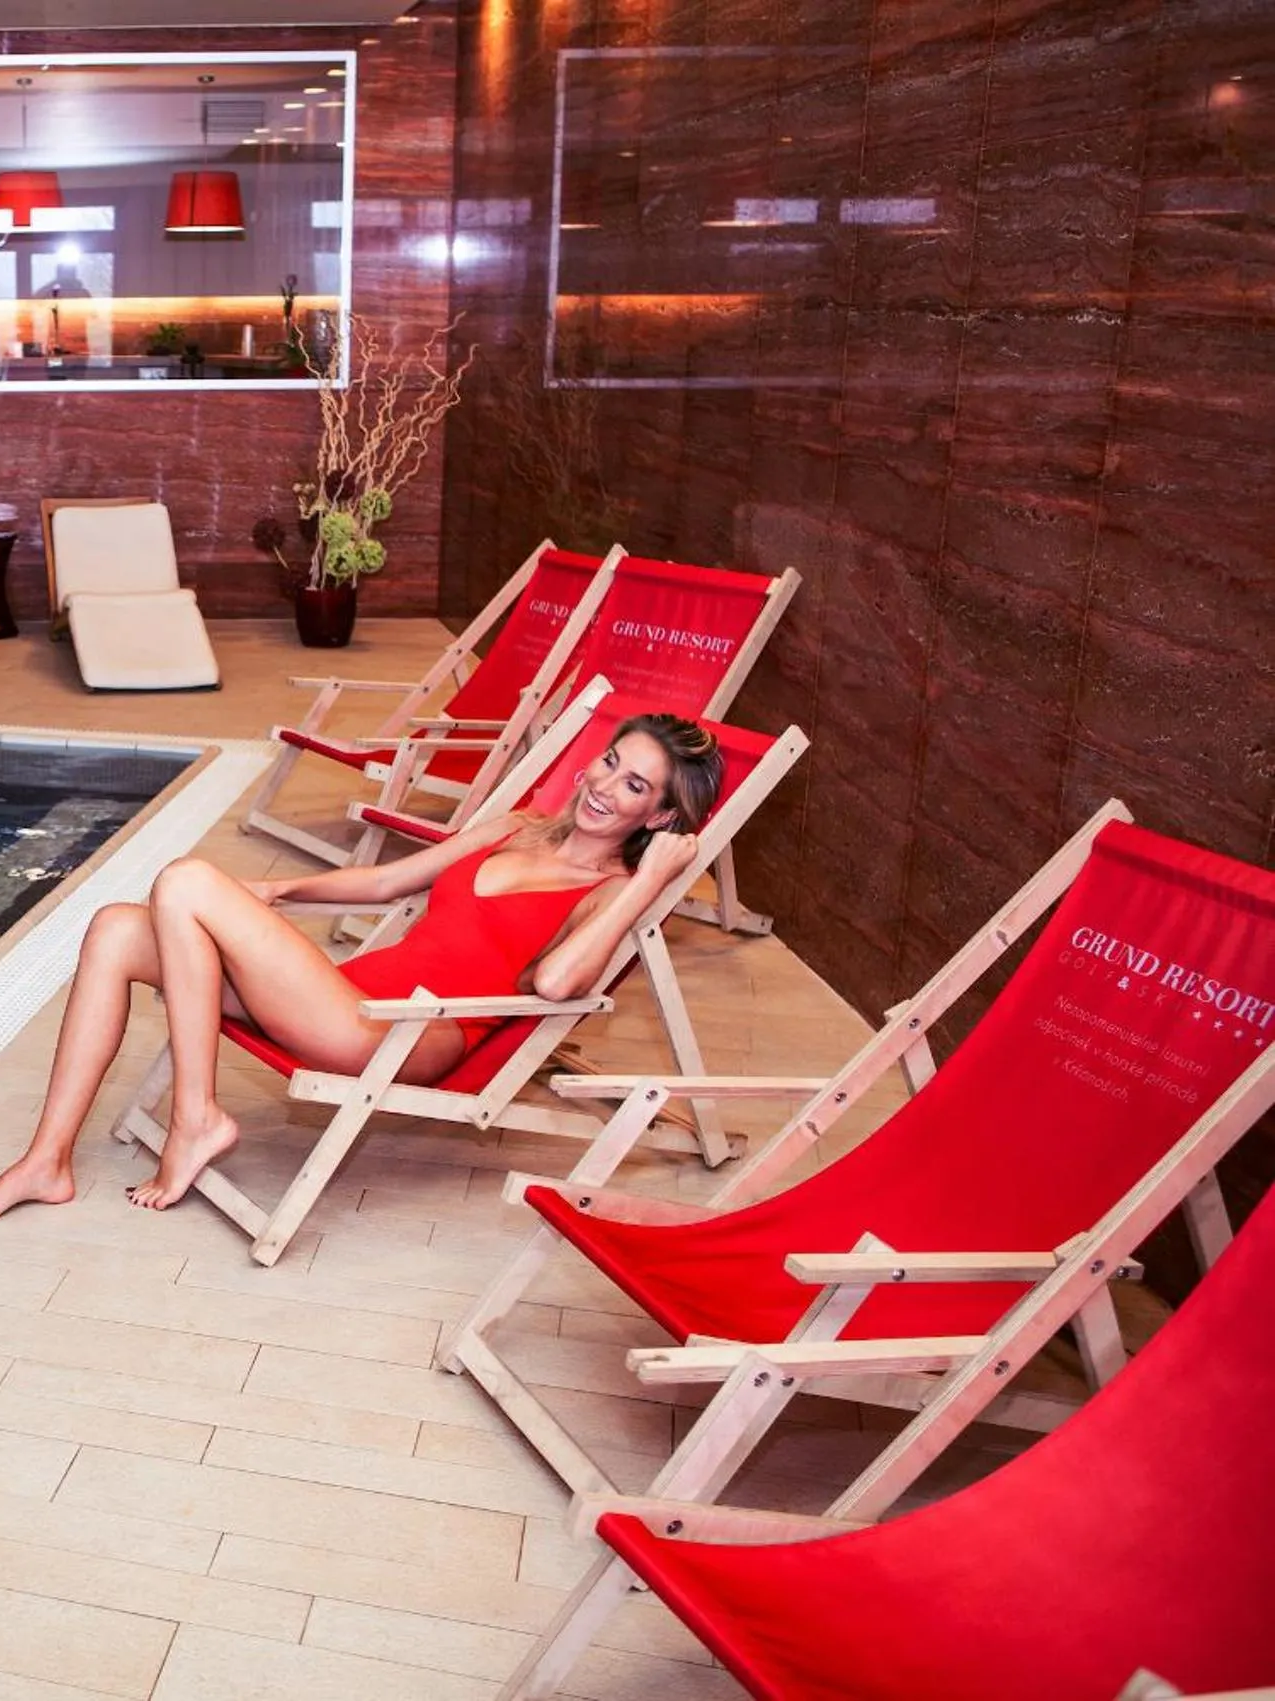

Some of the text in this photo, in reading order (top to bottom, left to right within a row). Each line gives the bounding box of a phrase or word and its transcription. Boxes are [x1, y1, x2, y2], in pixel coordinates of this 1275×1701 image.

[612, 620, 666, 641] GRUND
[668, 629, 735, 654] RESORT
[1071, 926, 1275, 1029] GRUND RESORT
[1117, 976, 1130, 990] &
